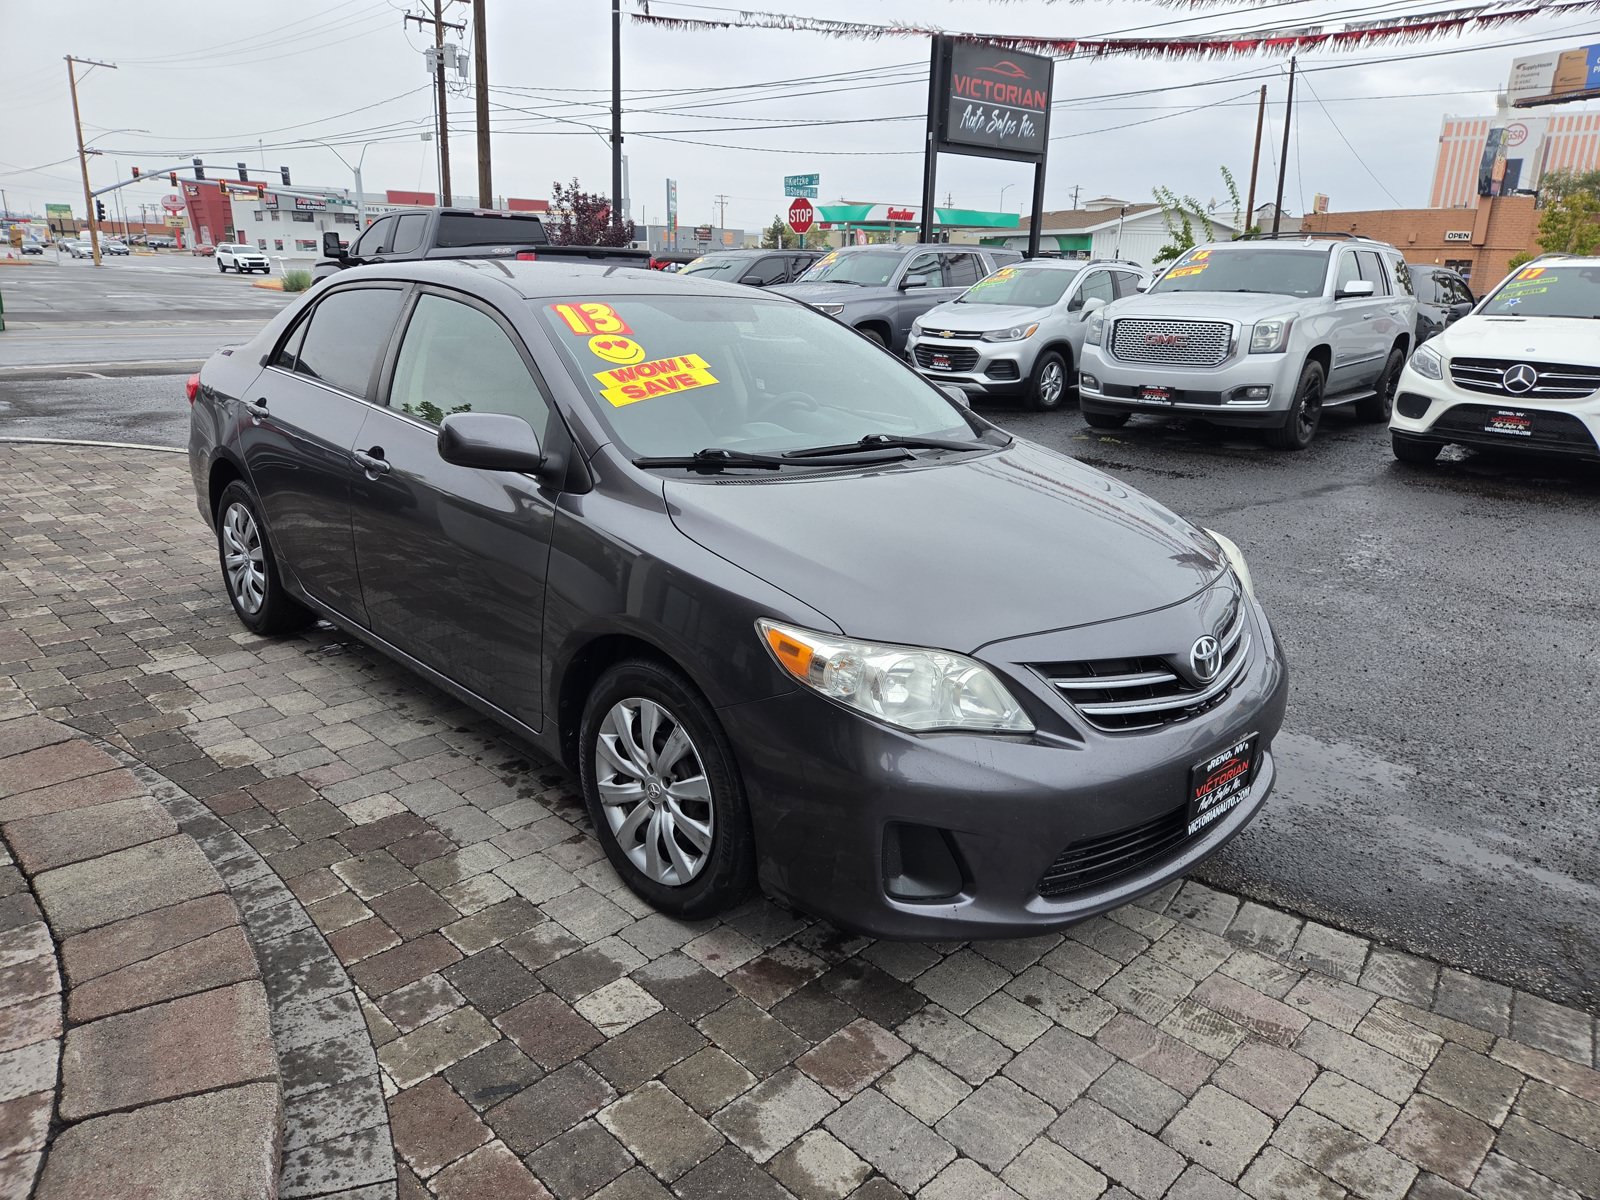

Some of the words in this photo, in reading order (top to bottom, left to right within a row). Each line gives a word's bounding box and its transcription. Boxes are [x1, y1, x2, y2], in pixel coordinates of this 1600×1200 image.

[953, 74, 1047, 110] VICTORIAN
[960, 104, 985, 133] Auto
[986, 109, 1017, 139] Sales
[789, 177, 809, 186] Kietzke
[790, 187, 811, 197] Stewart
[790, 209, 812, 223] STOP
[1517, 268, 1546, 280] 17
[556, 303, 625, 334] 13
[1145, 334, 1188, 347] GMC
[608, 358, 680, 384] WOW
[620, 373, 700, 400] SAVE
[1195, 760, 1249, 798] VICTORIAN
[1188, 786, 1251, 836] VICTORIANAUTO.COM
